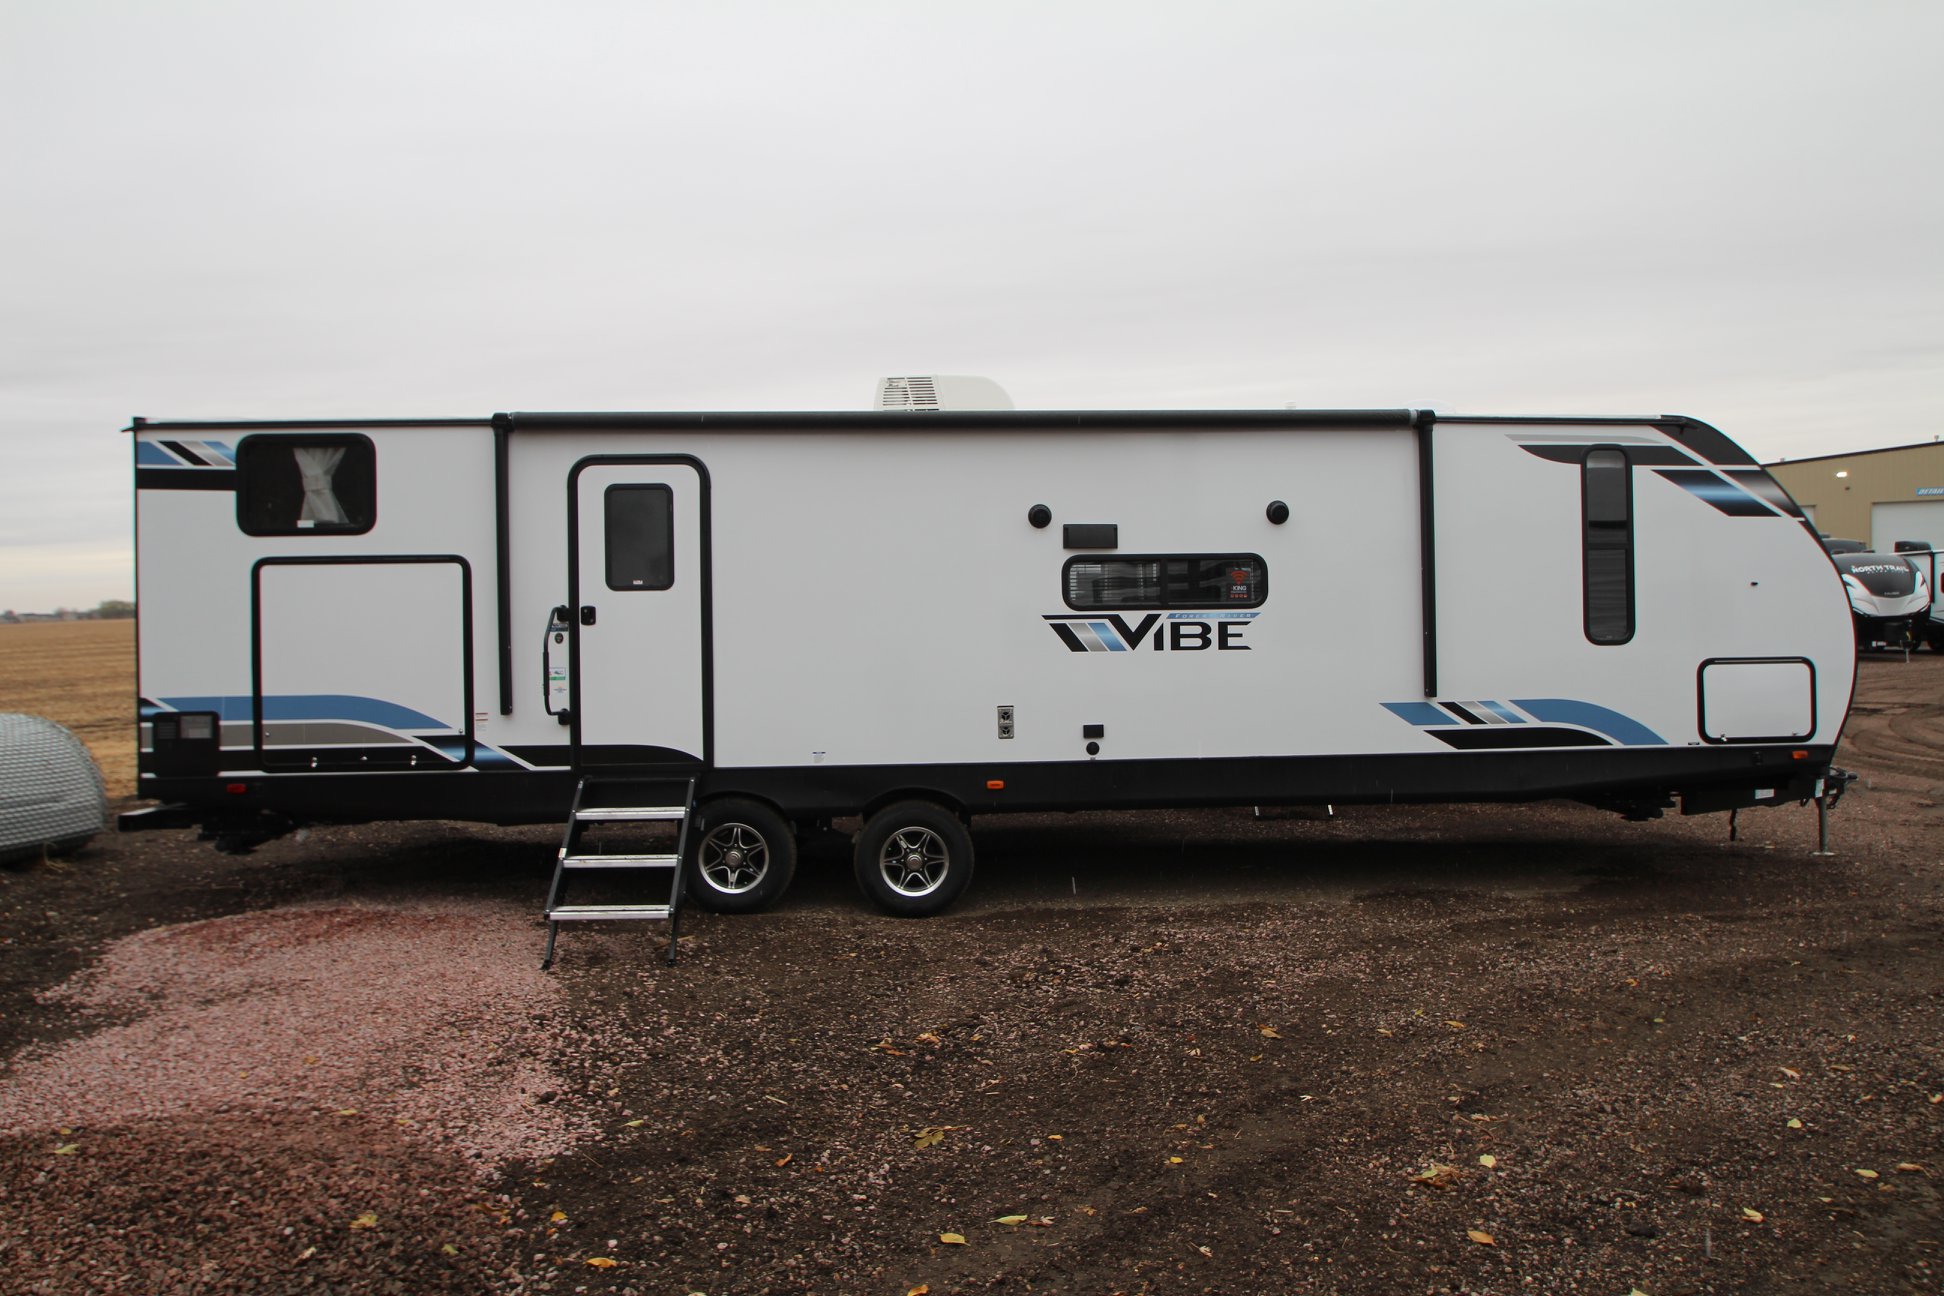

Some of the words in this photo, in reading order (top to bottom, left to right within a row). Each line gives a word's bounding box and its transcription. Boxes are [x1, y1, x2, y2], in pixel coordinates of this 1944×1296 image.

[1851, 565, 1883, 573] NORTH
[1884, 564, 1910, 572] TRAIL
[1105, 613, 1252, 651] VIBE
